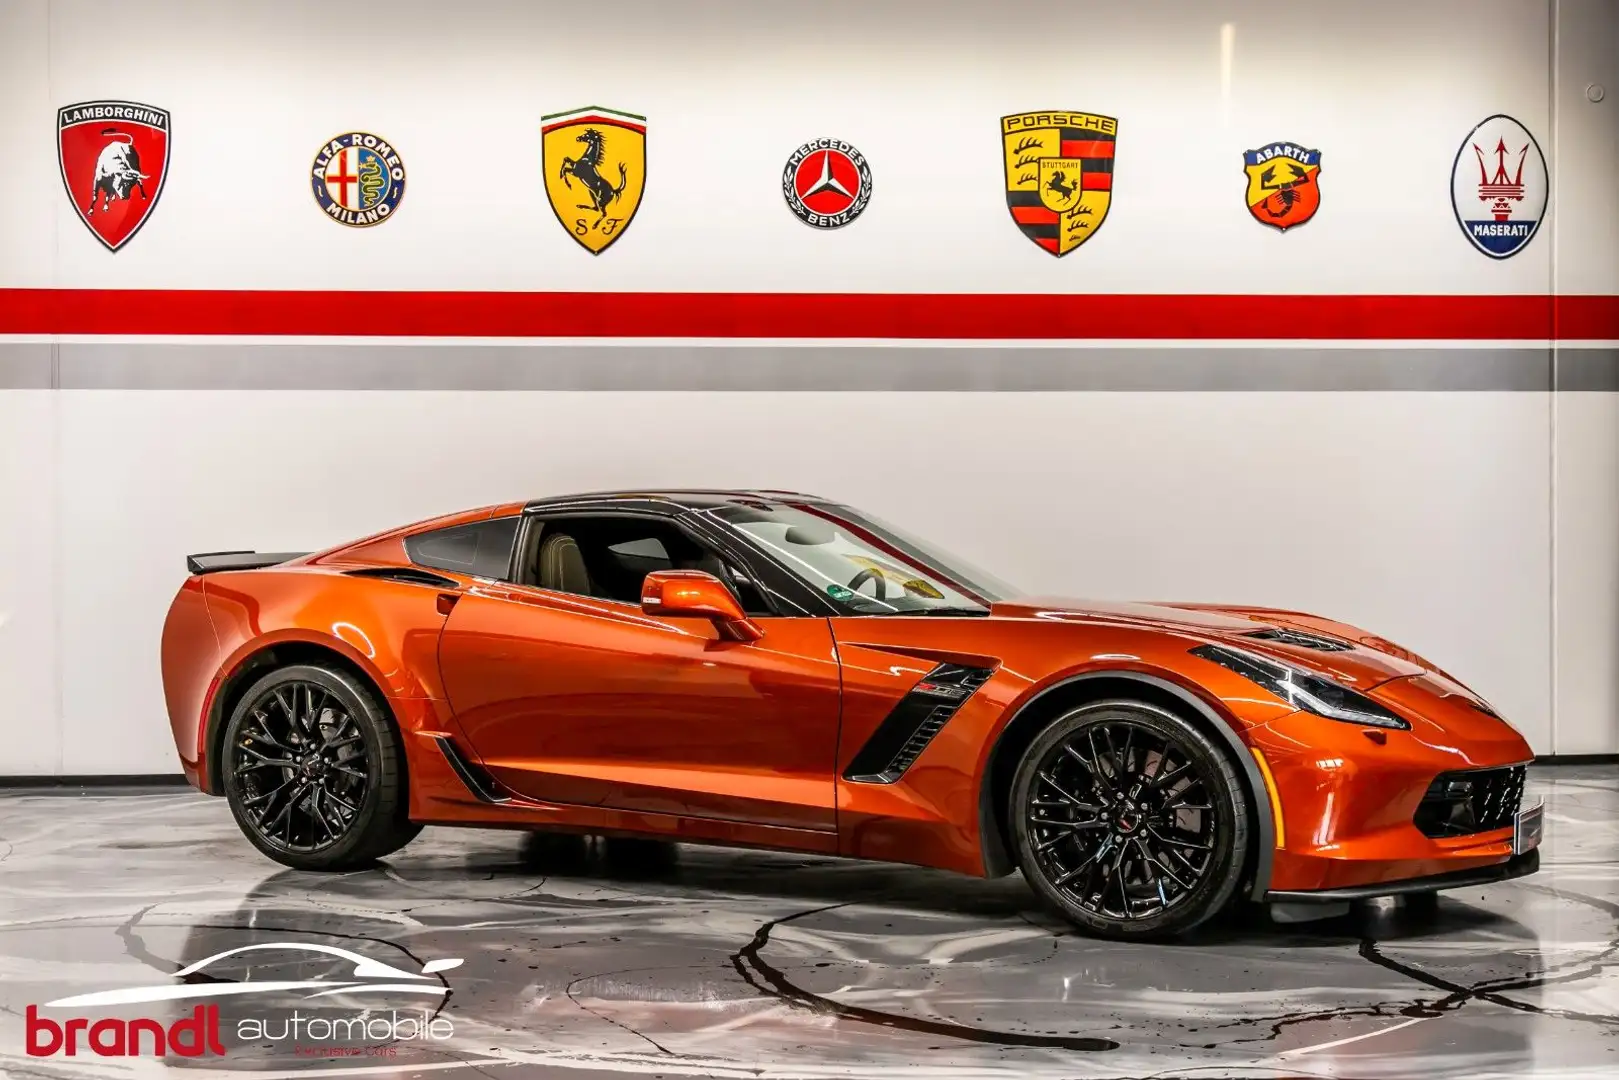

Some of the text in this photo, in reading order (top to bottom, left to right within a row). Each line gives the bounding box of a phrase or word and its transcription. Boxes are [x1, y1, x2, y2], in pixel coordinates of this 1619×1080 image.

[64, 107, 164, 126] LAMBORGHINI
[1007, 115, 1113, 132] PORSCHE
[790, 139, 864, 166] MERCEDES
[1256, 145, 1309, 164] ABARTH
[1042, 161, 1078, 169] STUTTGART
[327, 203, 390, 224] MILANO
[808, 213, 850, 226] BENZ
[1474, 225, 1528, 236] MASERATI
